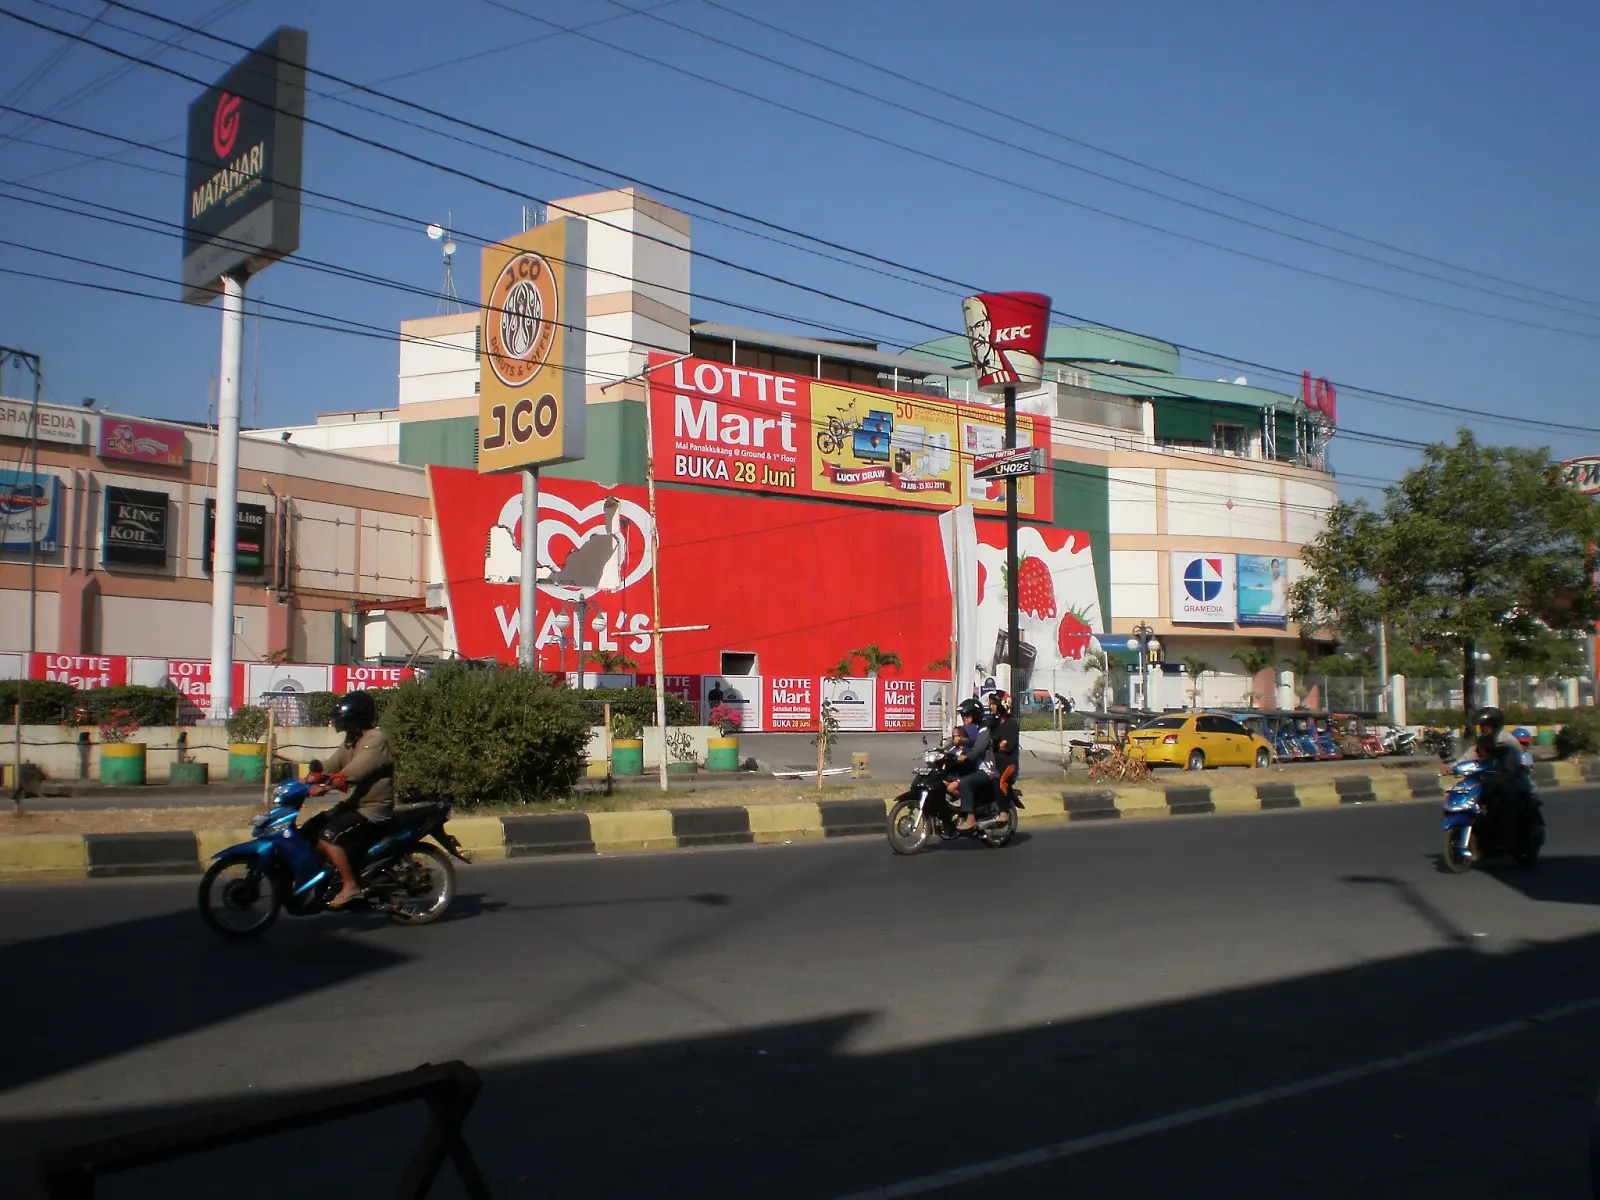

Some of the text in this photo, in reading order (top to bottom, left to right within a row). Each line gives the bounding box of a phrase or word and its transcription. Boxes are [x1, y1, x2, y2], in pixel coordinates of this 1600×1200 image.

[192, 140, 265, 218] MATAHARI
[505, 257, 541, 291] J.CO
[995, 324, 1032, 342] KFC
[526, 320, 552, 371] COFFEE
[674, 361, 796, 406] LOTTE
[482, 393, 558, 451] J.CO
[674, 394, 798, 453] Mart
[741, 449, 766, 459] Ground
[780, 454, 796, 463] Floor
[675, 454, 796, 488] BUKA 28 Juni
[1000, 461, 1029, 473] 14022
[836, 470, 885, 482] LUCKY DRAW
[119, 505, 161, 522] KING
[110, 525, 149, 541] KOIL
[46, 656, 110, 671] LOTTE
[46, 670, 110, 691] Mart
[346, 667, 401, 681] LOTTE
[647, 676, 690, 687] LTTE
[772, 678, 811, 689] LOTTE
[884, 680, 915, 691] LOTTE
[772, 690, 811, 704] Mart
[884, 691, 915, 705] Mart
[772, 719, 791, 728] BUKA
[884, 720, 900, 728] BUKA
